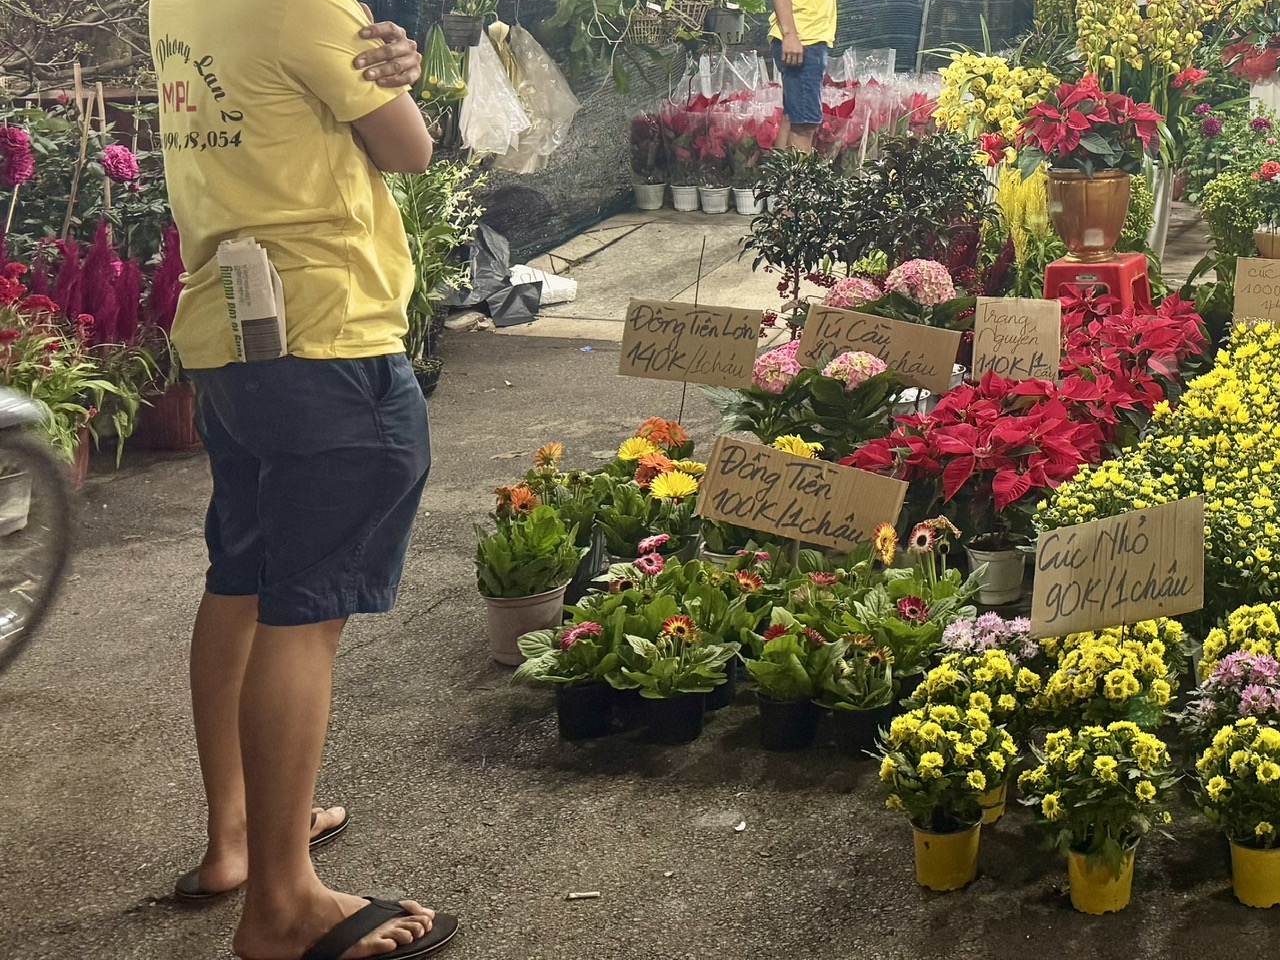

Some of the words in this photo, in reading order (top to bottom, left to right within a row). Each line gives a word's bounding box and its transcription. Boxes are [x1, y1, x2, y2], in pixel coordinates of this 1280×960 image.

[162, 80, 197, 114] MPL
[193, 55, 226, 103] Lan
[220, 110, 244, 123] 2
[980, 301, 1029, 336] Trang
[720, 444, 782, 502] Đồng
[785, 461, 839, 501] Tiền
[1038, 532, 1089, 572] Cúc
[1092, 514, 1149, 563] Nhỏ
